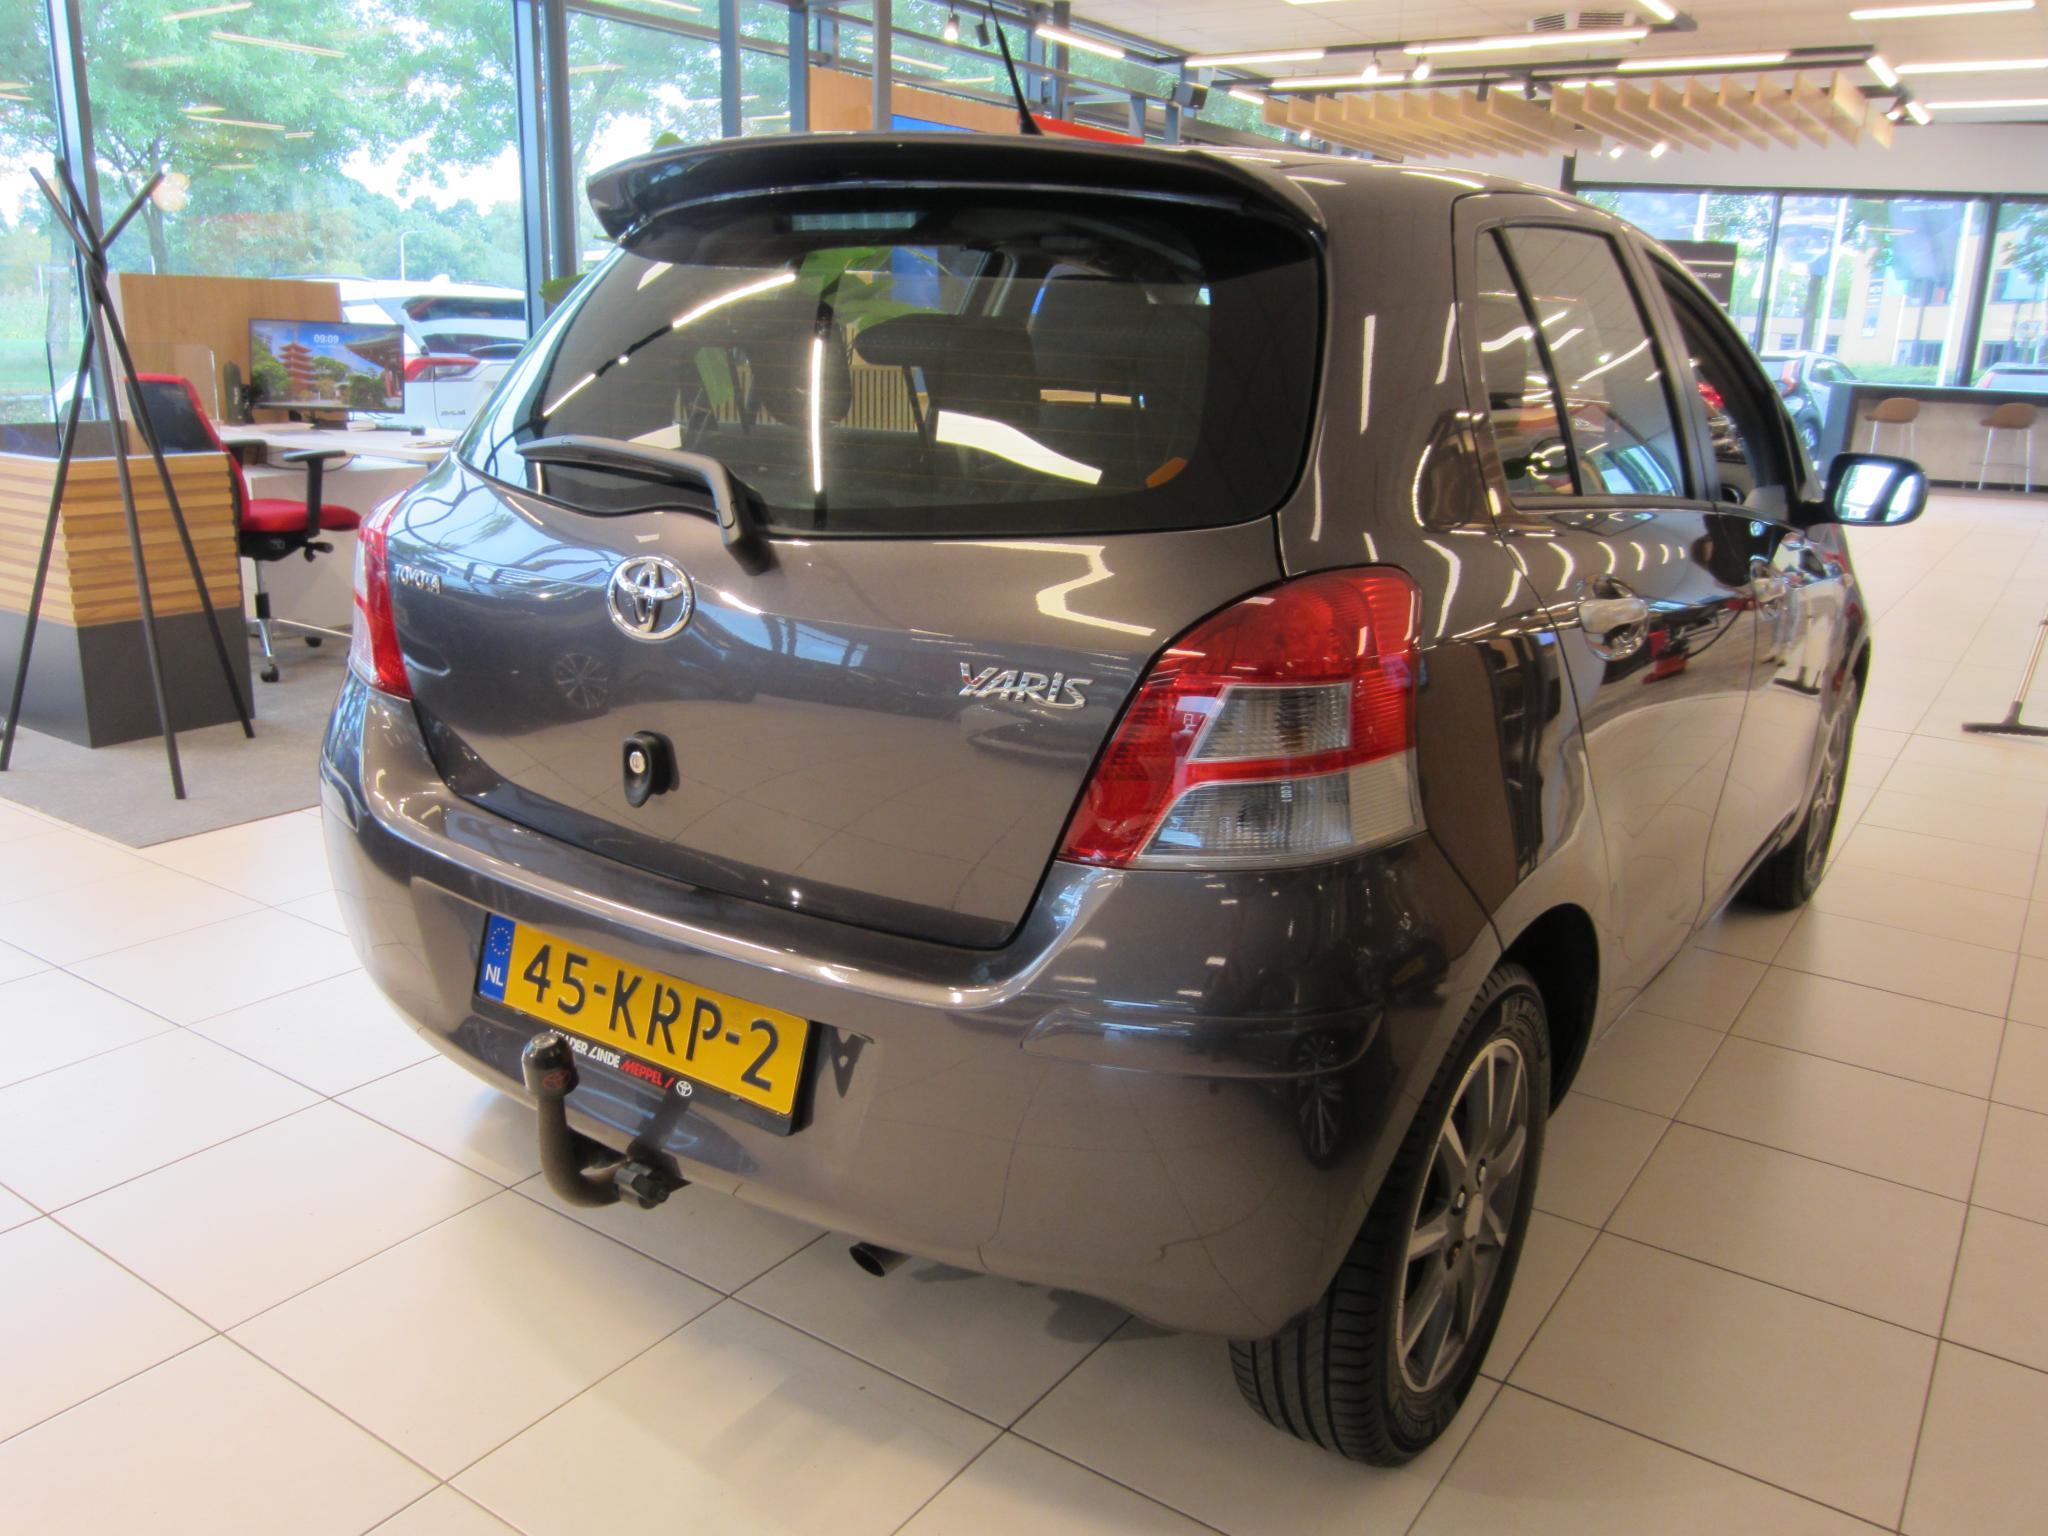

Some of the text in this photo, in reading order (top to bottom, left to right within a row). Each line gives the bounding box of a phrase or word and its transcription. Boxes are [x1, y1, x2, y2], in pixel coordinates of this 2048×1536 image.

[313, 334, 340, 344] 09:09
[394, 563, 441, 595] TOYOTA
[958, 661, 1094, 710] YARIS
[485, 963, 504, 987] NL
[522, 943, 780, 1092] 45-KRP-2
[588, 1046, 621, 1069] LINDE
[620, 1060, 663, 1086] MEPPEL
